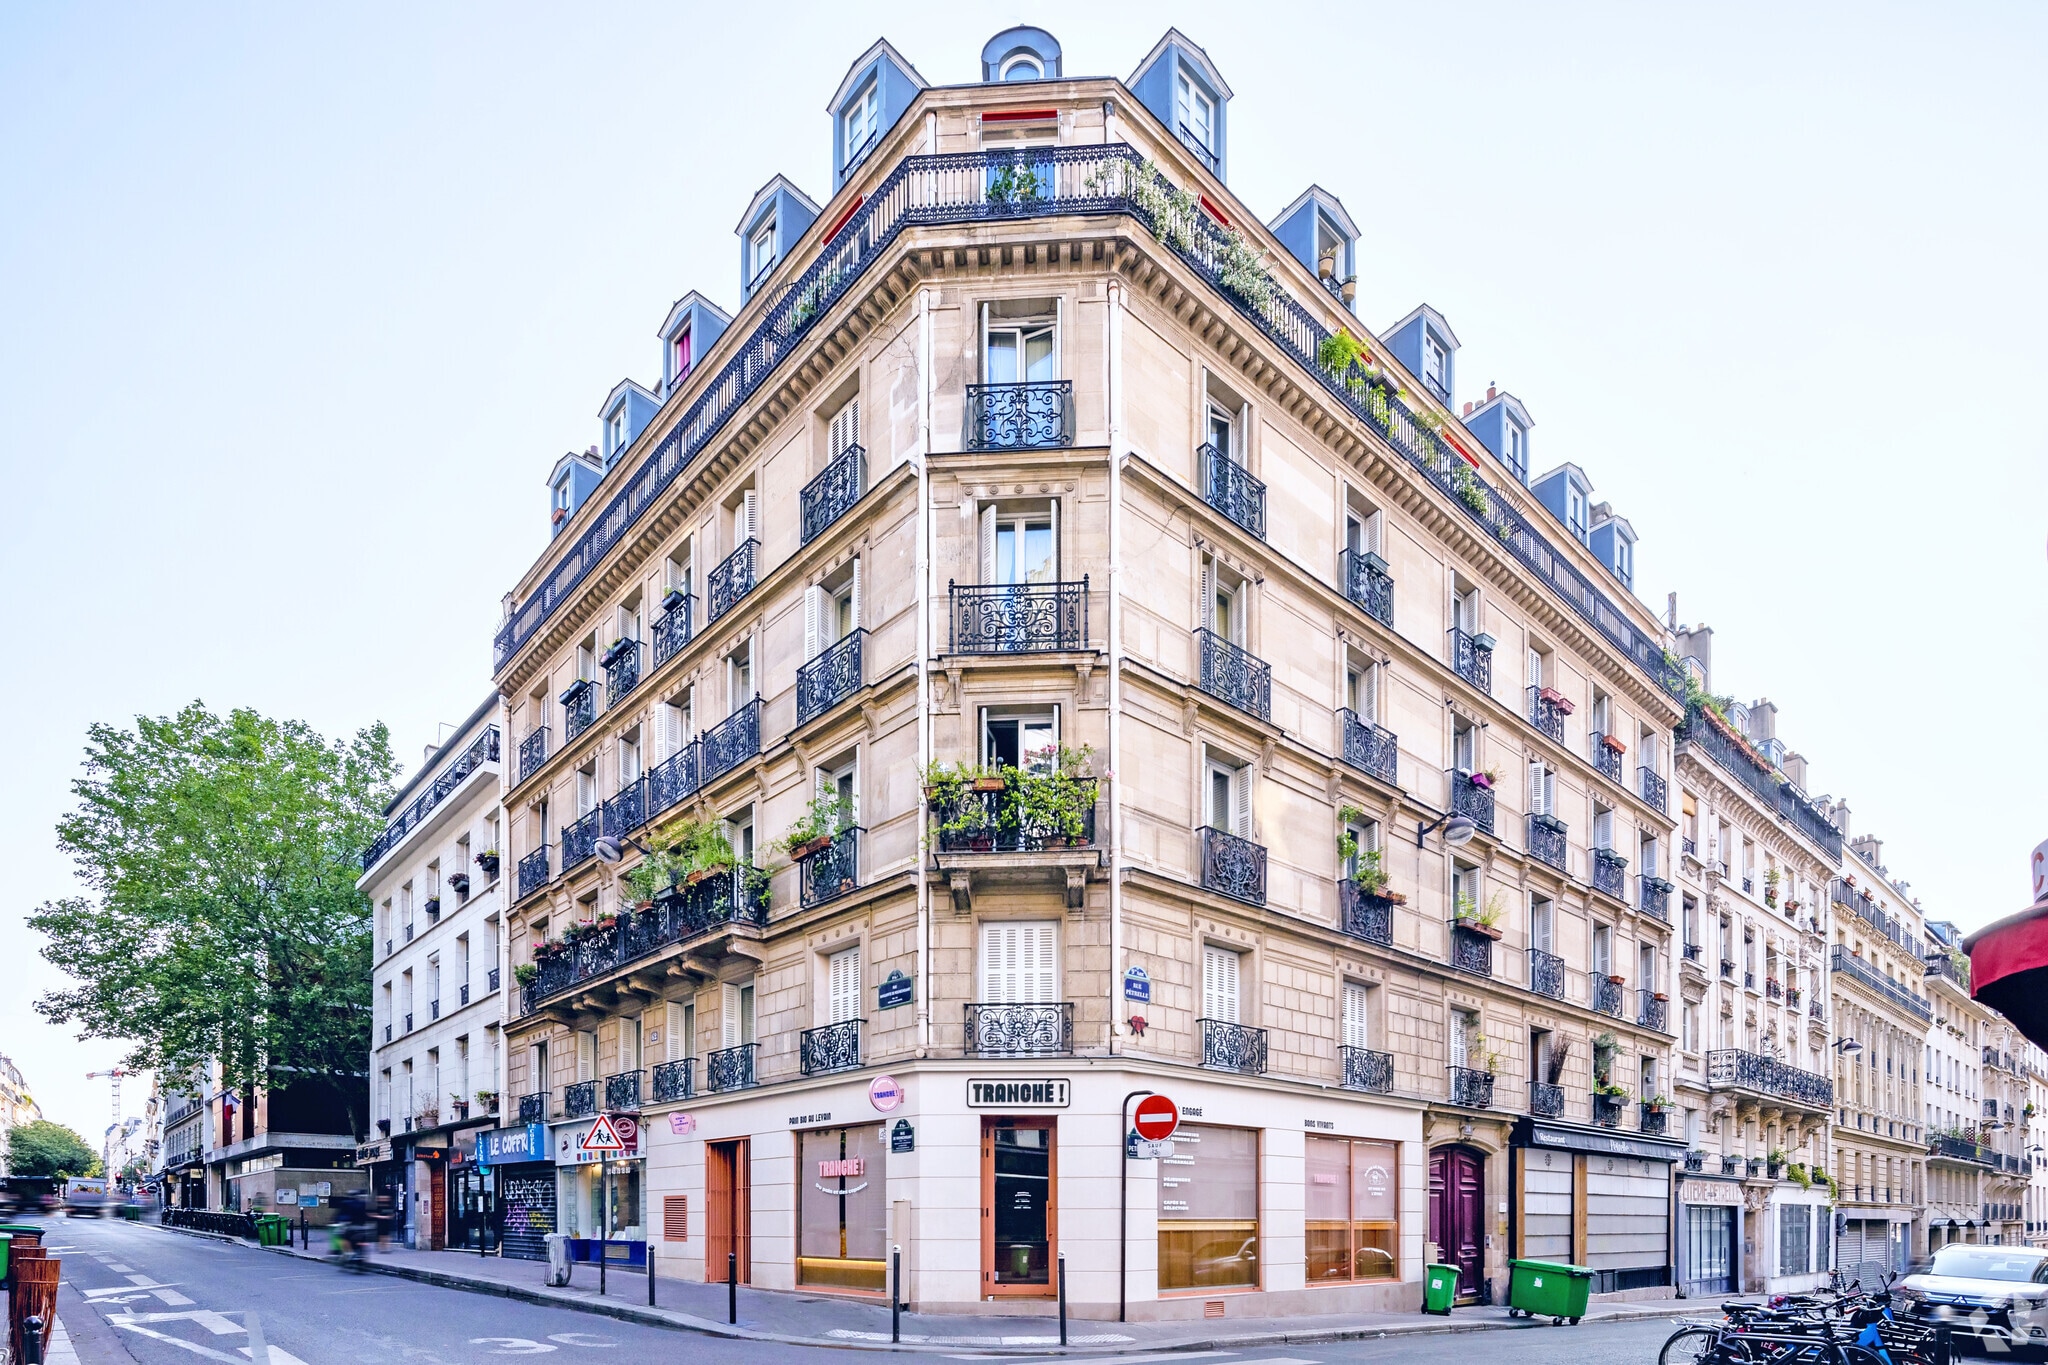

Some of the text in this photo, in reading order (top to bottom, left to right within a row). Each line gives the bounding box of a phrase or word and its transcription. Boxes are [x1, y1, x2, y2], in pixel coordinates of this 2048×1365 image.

[973, 1080, 1065, 1103] TRANCHÉ !
[1182, 1106, 1203, 1117] ENGAGÉ
[789, 1116, 799, 1125] PAIN
[816, 1112, 831, 1122] LEVAIN
[1304, 1120, 1334, 1130] BONS VIVANTS
[490, 1138, 500, 1156] LE
[502, 1132, 528, 1154] COFFR
[1539, 1132, 1566, 1144] Restaurant
[818, 1154, 860, 1177] TRANCHÉ
